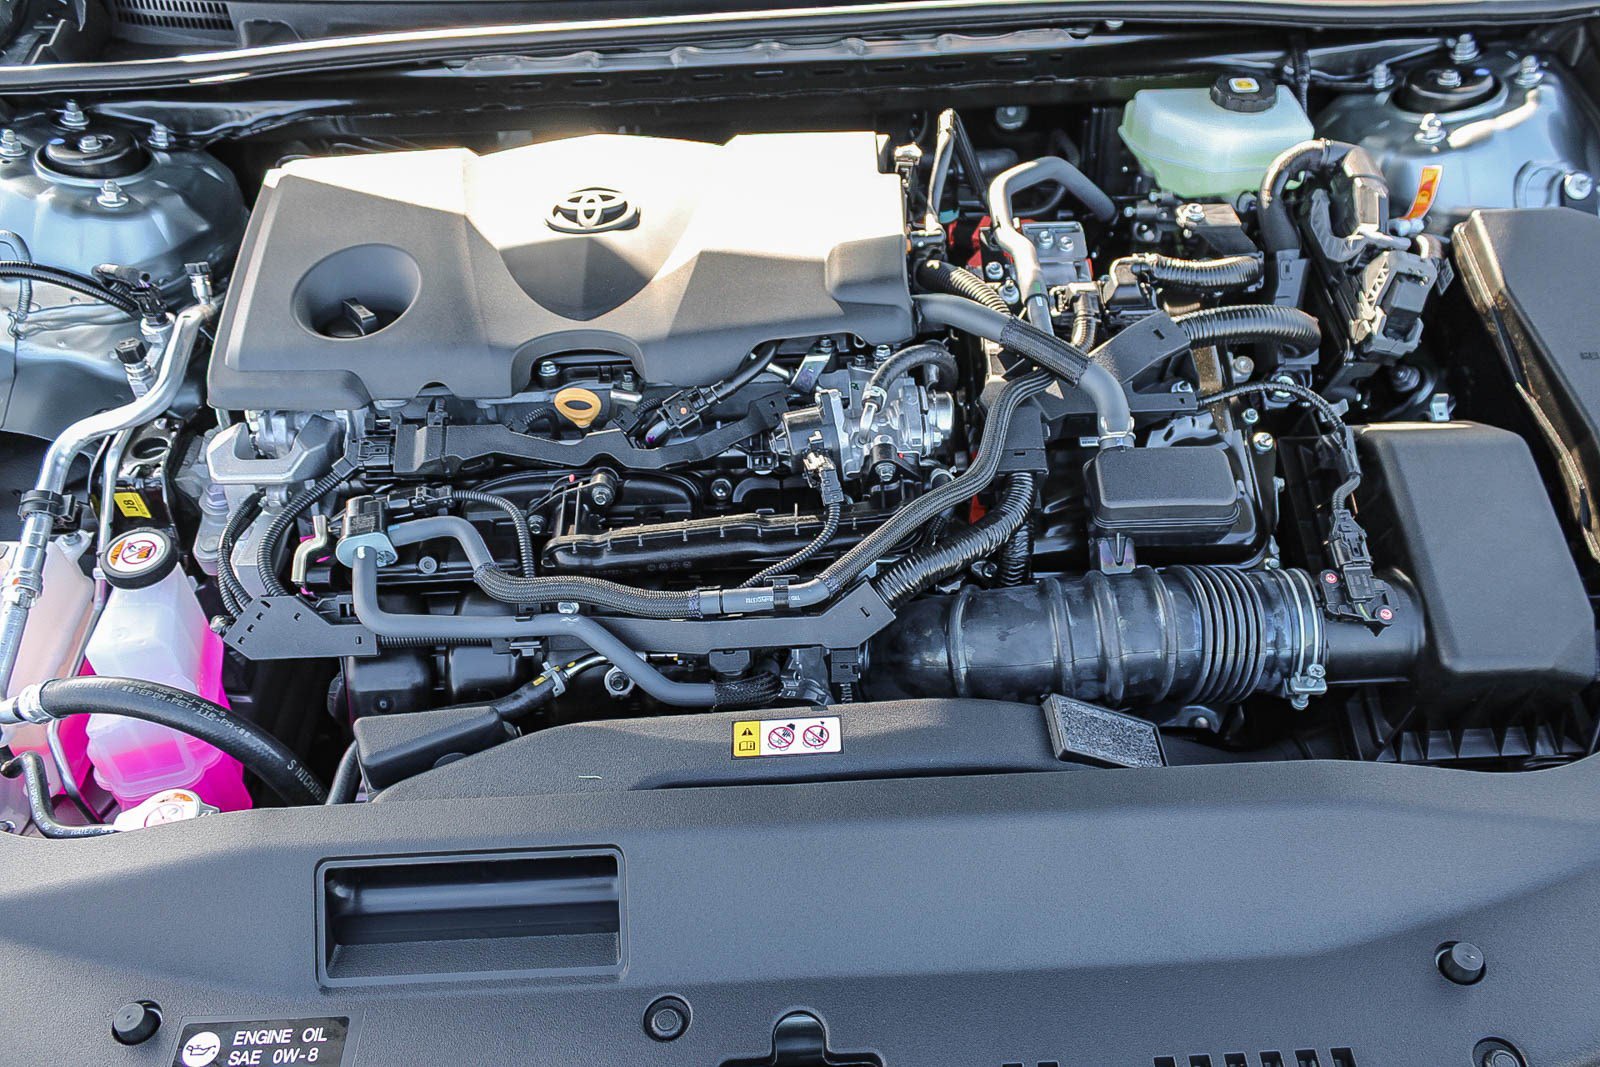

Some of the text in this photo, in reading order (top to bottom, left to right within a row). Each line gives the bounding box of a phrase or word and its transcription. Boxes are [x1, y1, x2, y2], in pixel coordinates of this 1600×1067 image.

[123, 499, 139, 512] J8
[233, 1027, 328, 1046] ENGINE OIL
[228, 1048, 319, 1066] SAE 0W-8
